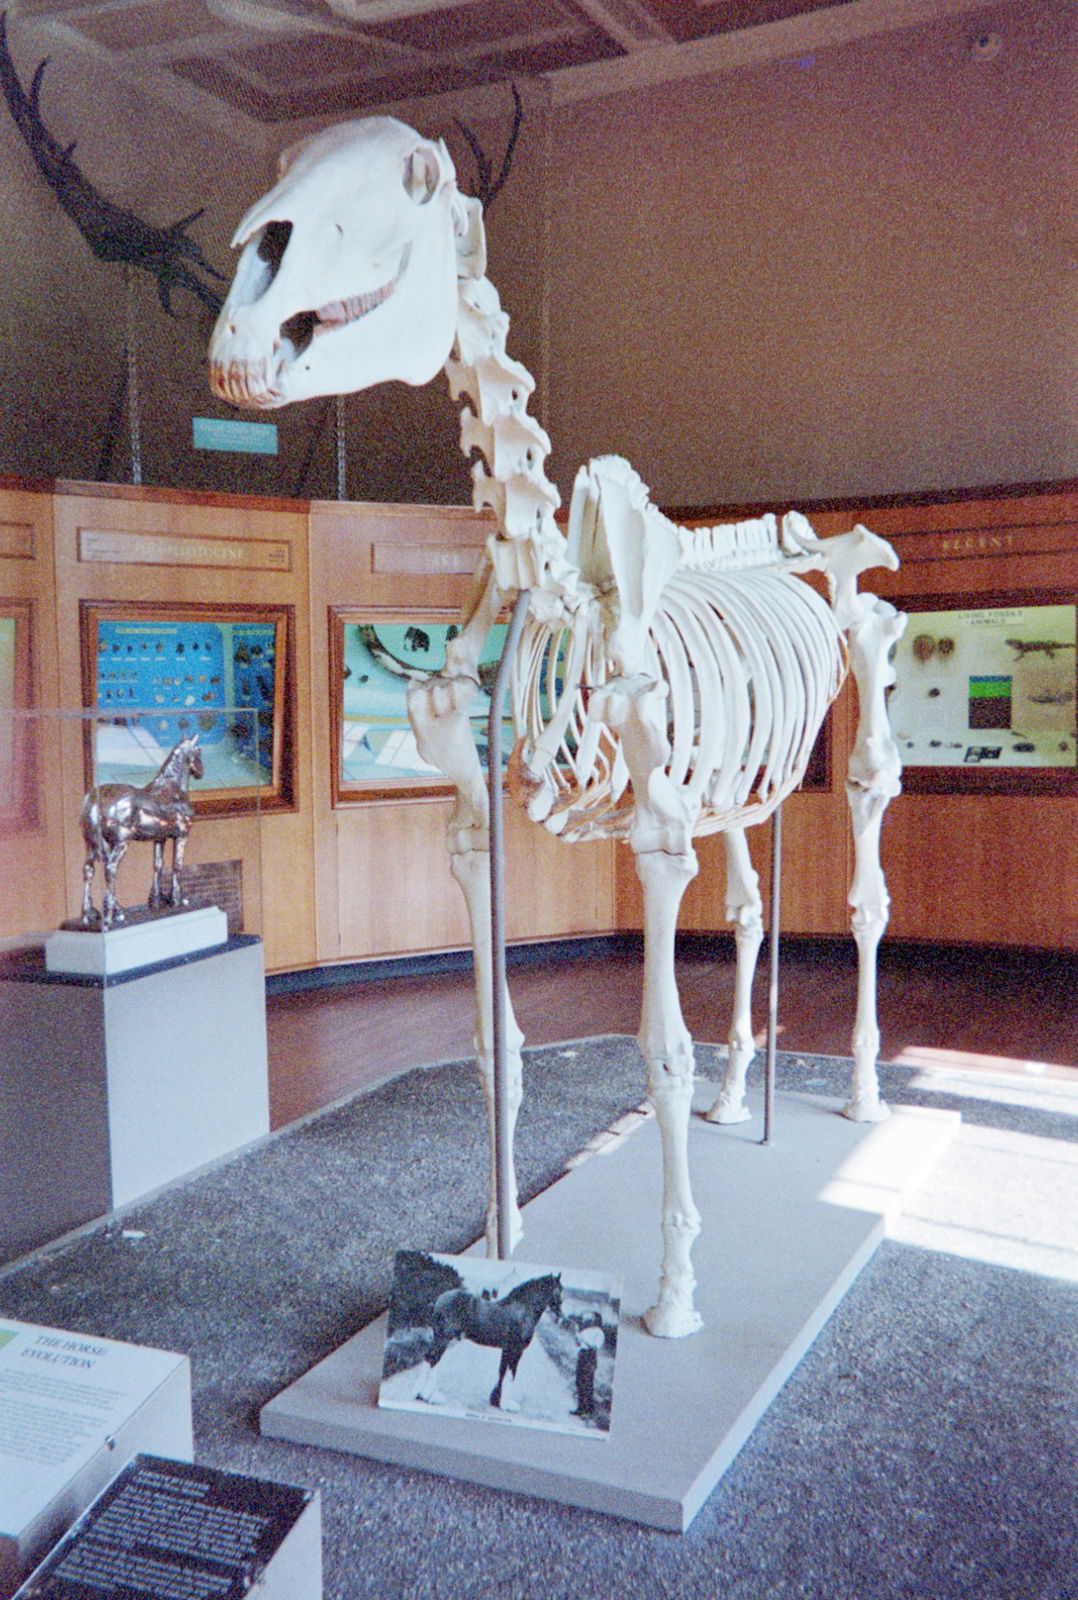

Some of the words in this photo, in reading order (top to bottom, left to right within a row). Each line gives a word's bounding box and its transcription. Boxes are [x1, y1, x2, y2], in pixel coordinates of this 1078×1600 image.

[35, 1335, 59, 1348] THE
[61, 1339, 108, 1356] HORSE
[20, 1348, 96, 1369] EVOLUTION
